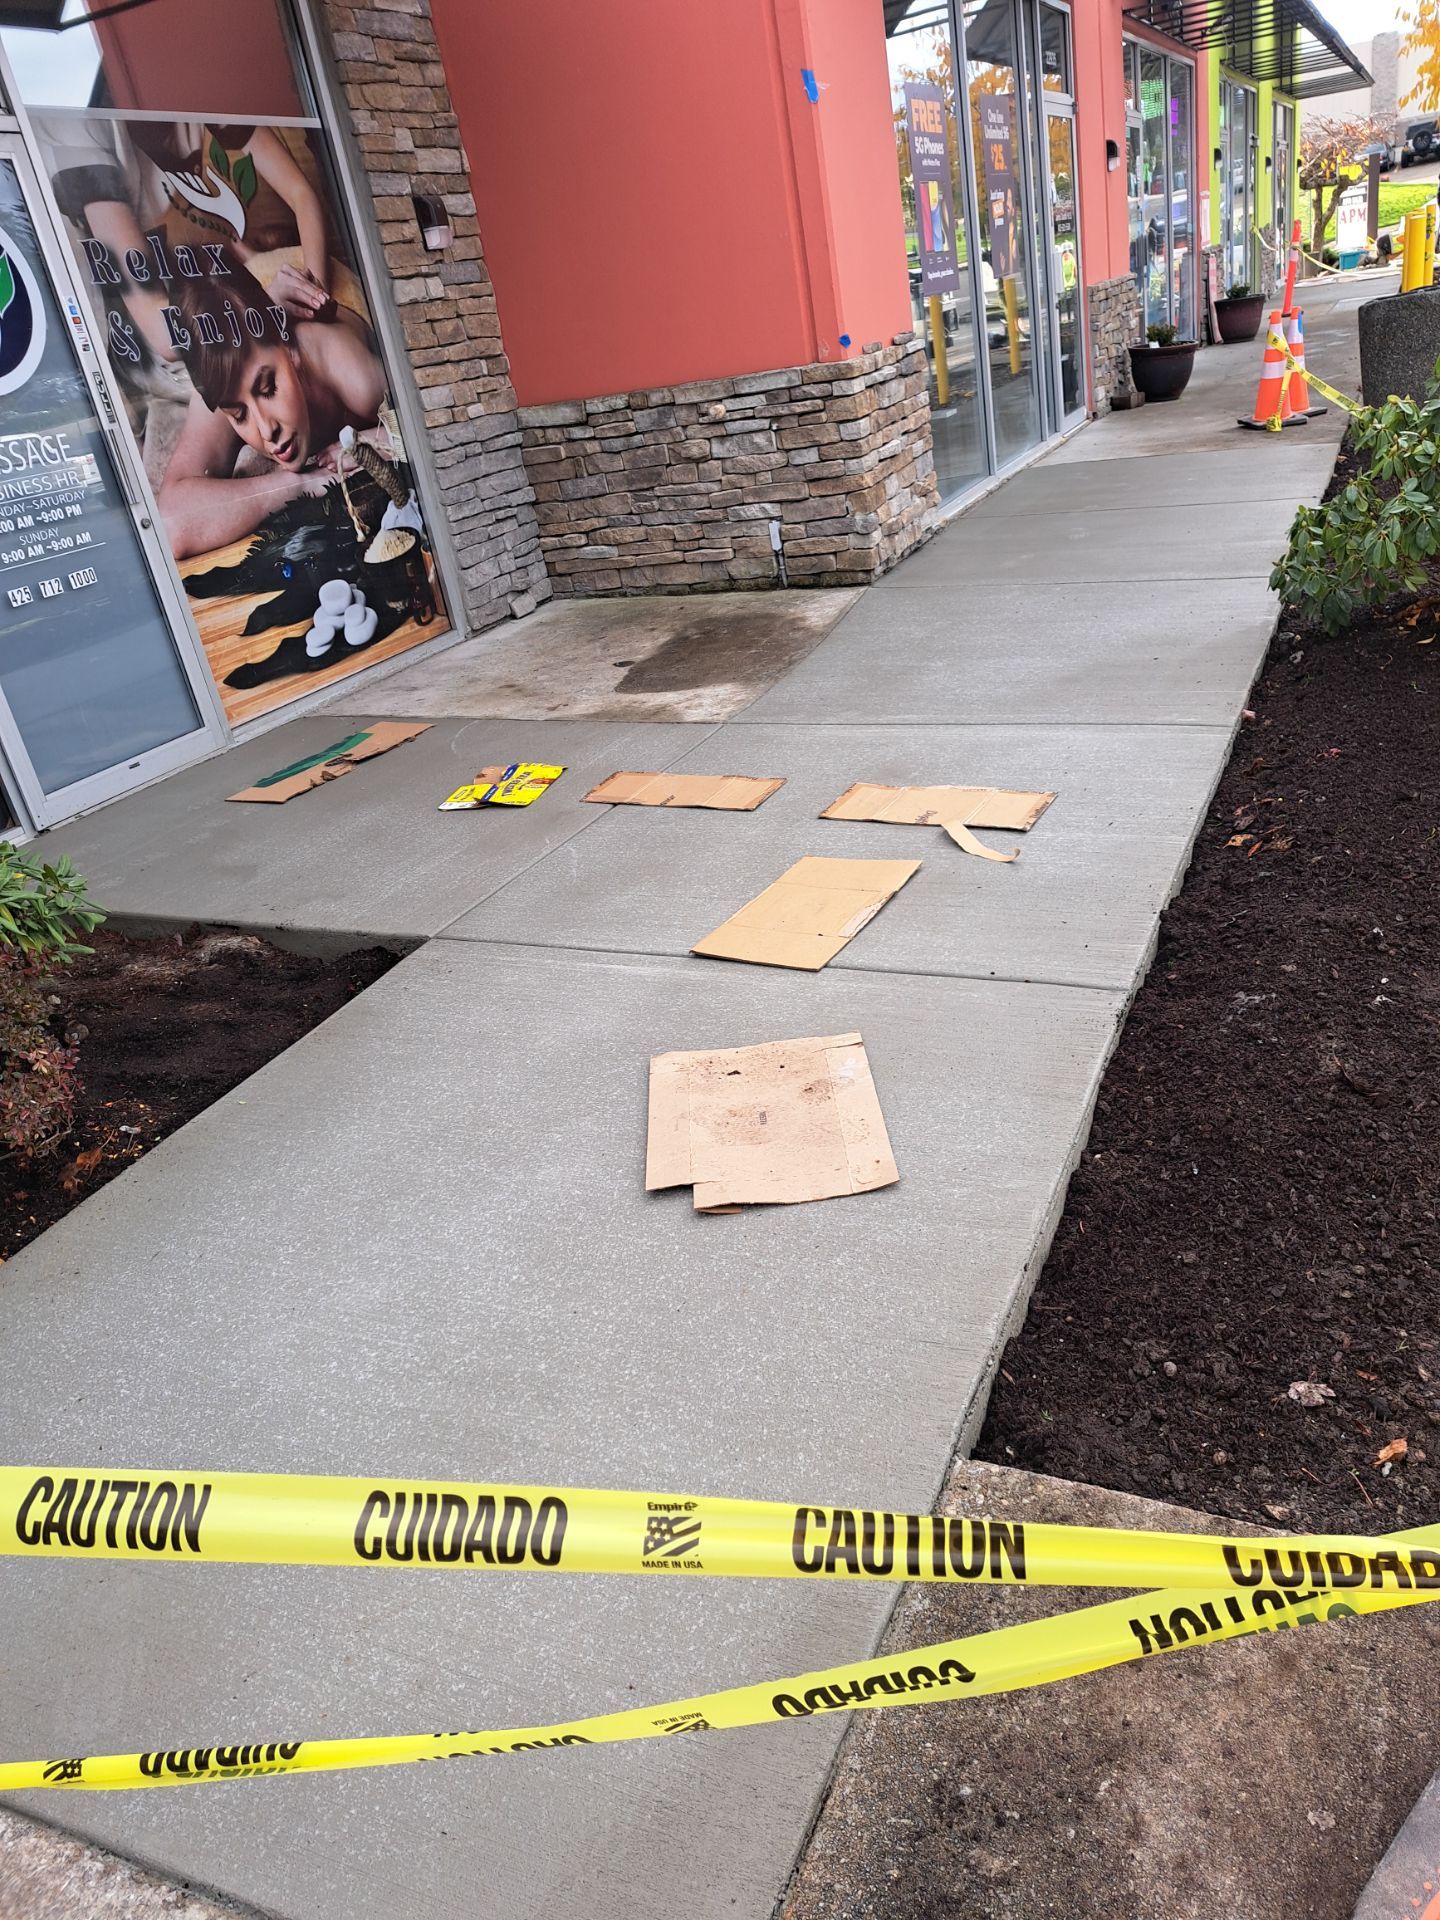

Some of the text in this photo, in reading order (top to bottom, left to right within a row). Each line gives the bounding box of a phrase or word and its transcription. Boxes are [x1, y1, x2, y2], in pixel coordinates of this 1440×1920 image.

[911, 98, 943, 133] FREE
[914, 136, 944, 155] 5G Phones
[78, 235, 231, 285] Relax
[108, 300, 290, 362] & Enjoy
[95, 375, 111, 412] PULL
[17, 514, 35, 529] AM
[65, 503, 82, 518] PM
[1, 548, 26, 563] 9:00
[28, 544, 45, 557] AM
[76, 531, 92, 545] AM
[19, 527, 59, 546] SUNDAY
[11, 569, 97, 606] 425 712 1000
[16, 1476, 568, 1566] CAUTION CUIDADO
[647, 1502, 698, 1513] Empire
[792, 1506, 1027, 1580] CAUTION
[642, 1560, 704, 1569] MADE IN USA
[651, 1711, 703, 1727] MADE IN USA
